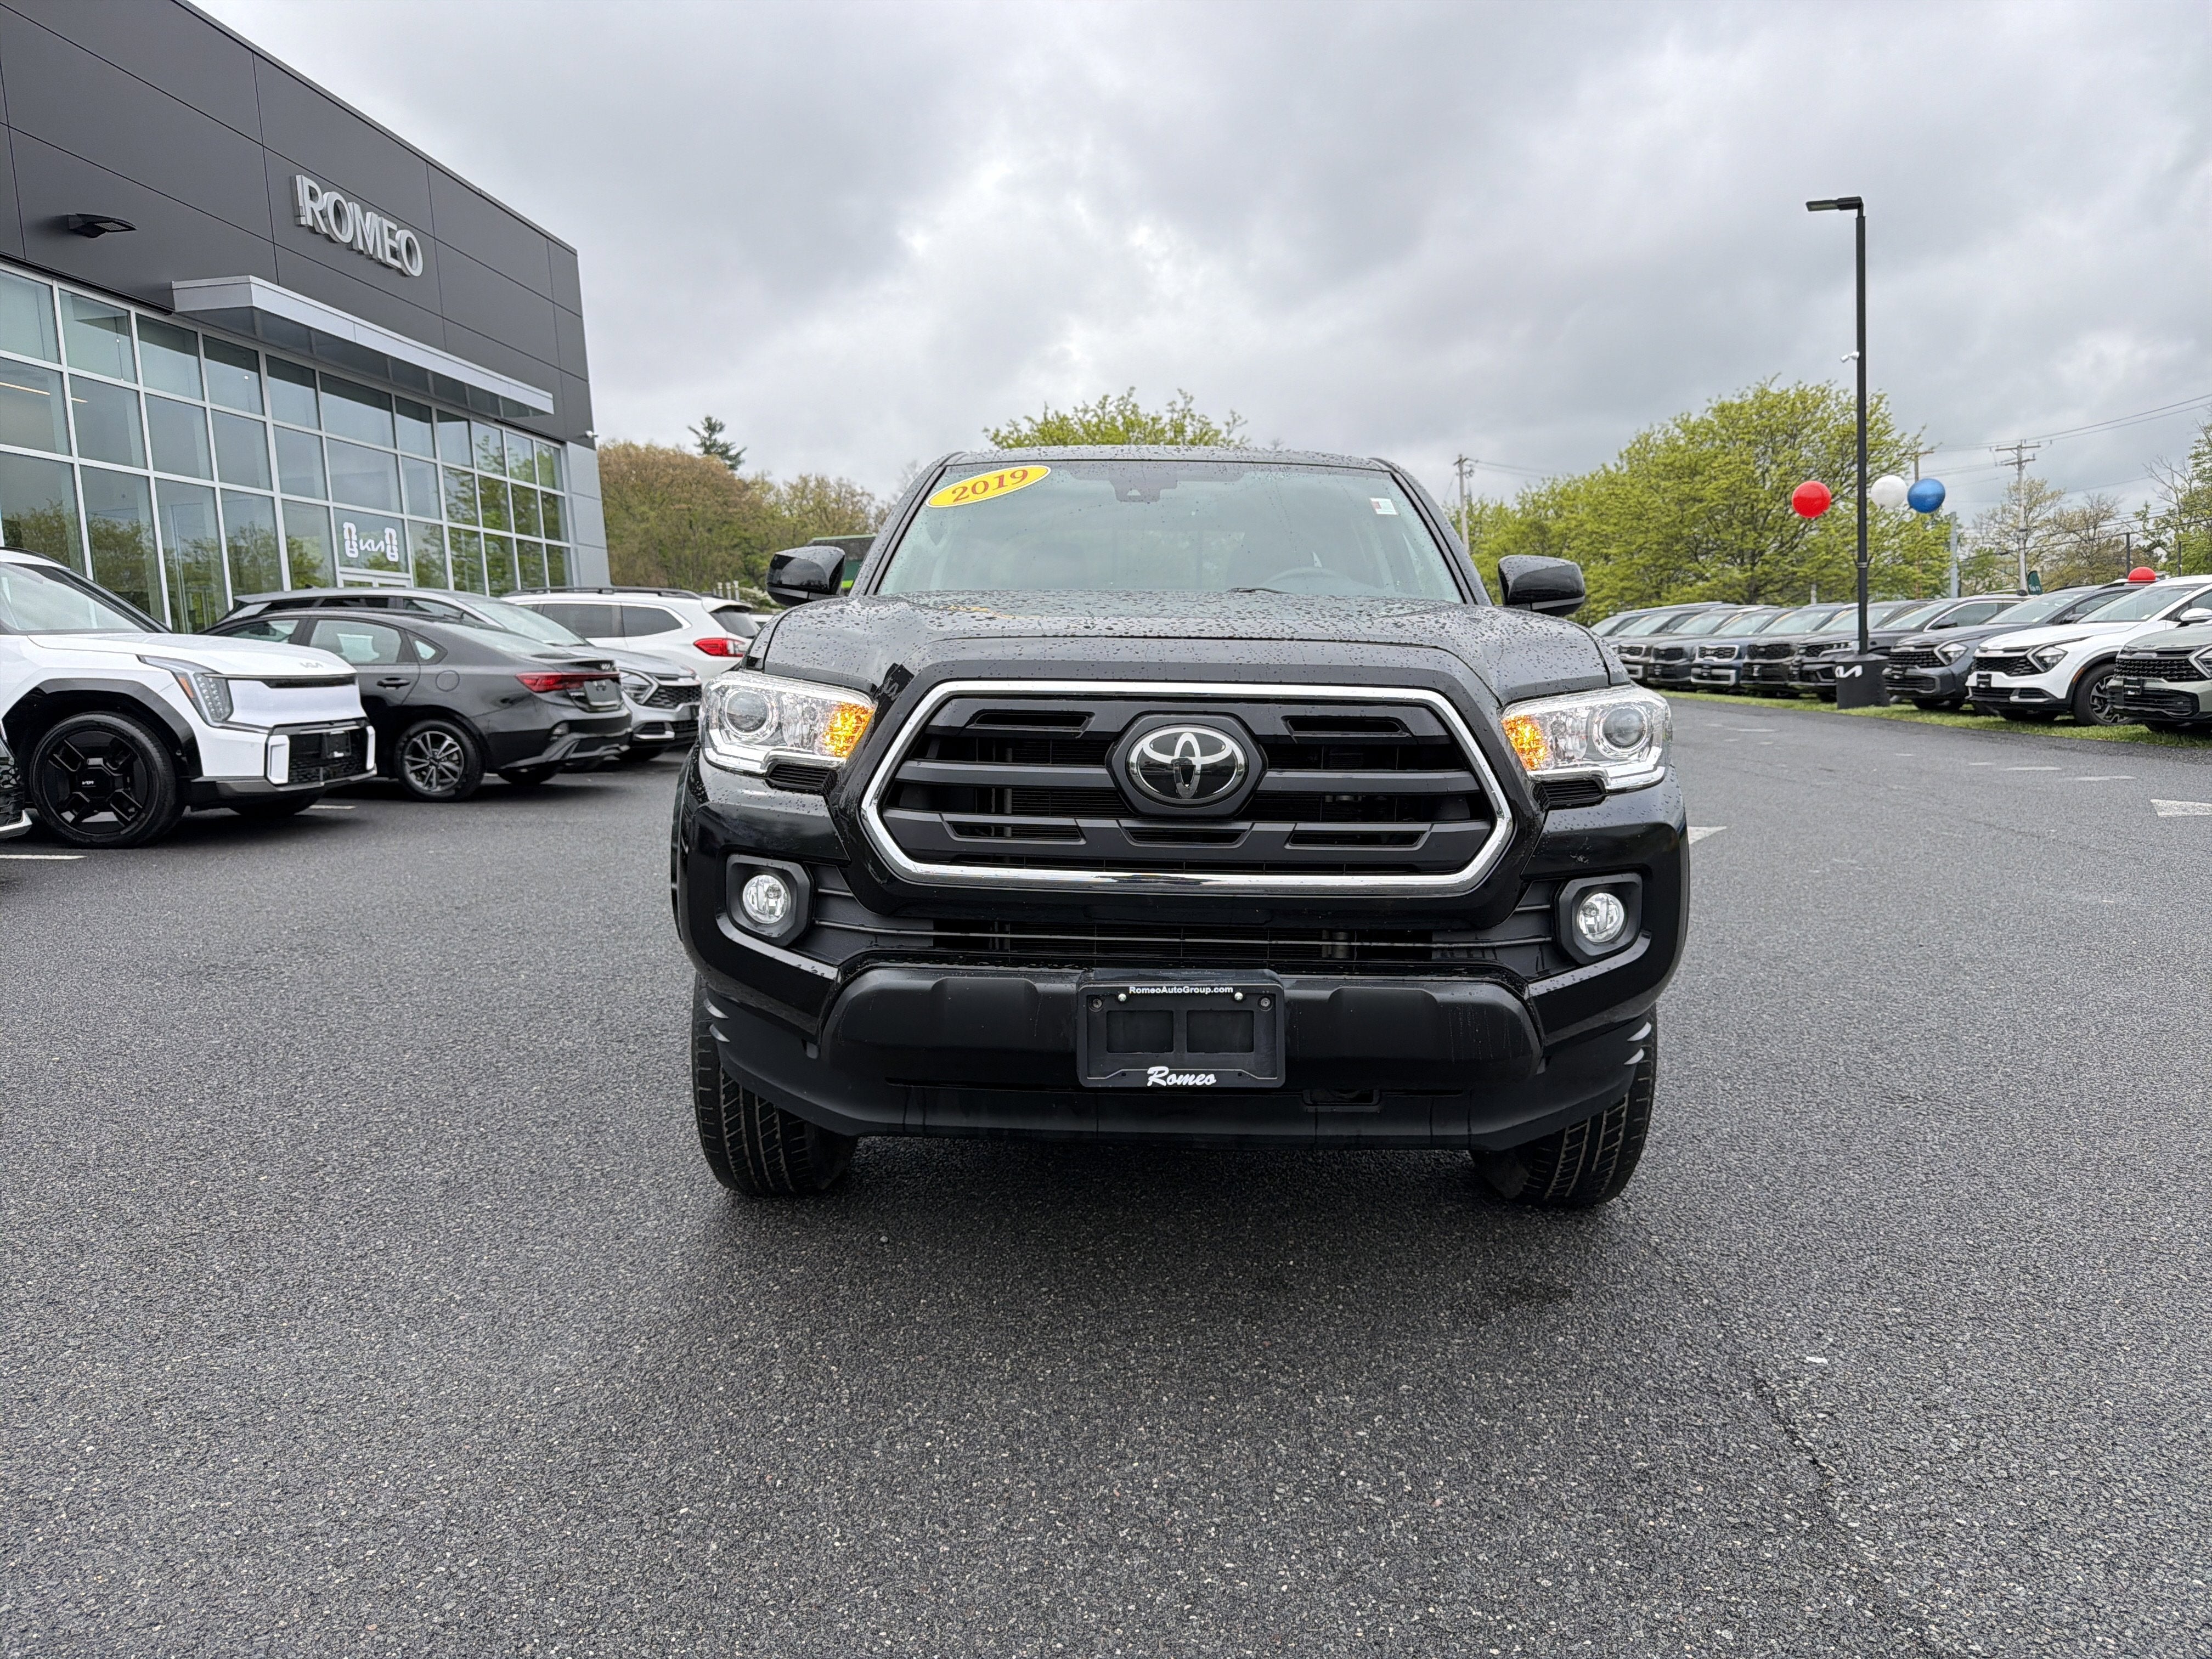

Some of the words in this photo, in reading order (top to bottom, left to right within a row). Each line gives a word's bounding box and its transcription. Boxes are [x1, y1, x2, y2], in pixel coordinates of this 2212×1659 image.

[296, 175, 423, 276] ROMEO
[951, 469, 1028, 503] 2019
[1129, 986, 1234, 995] RomeoAutoGroup.com
[1147, 1066, 1217, 1087] Romeo
